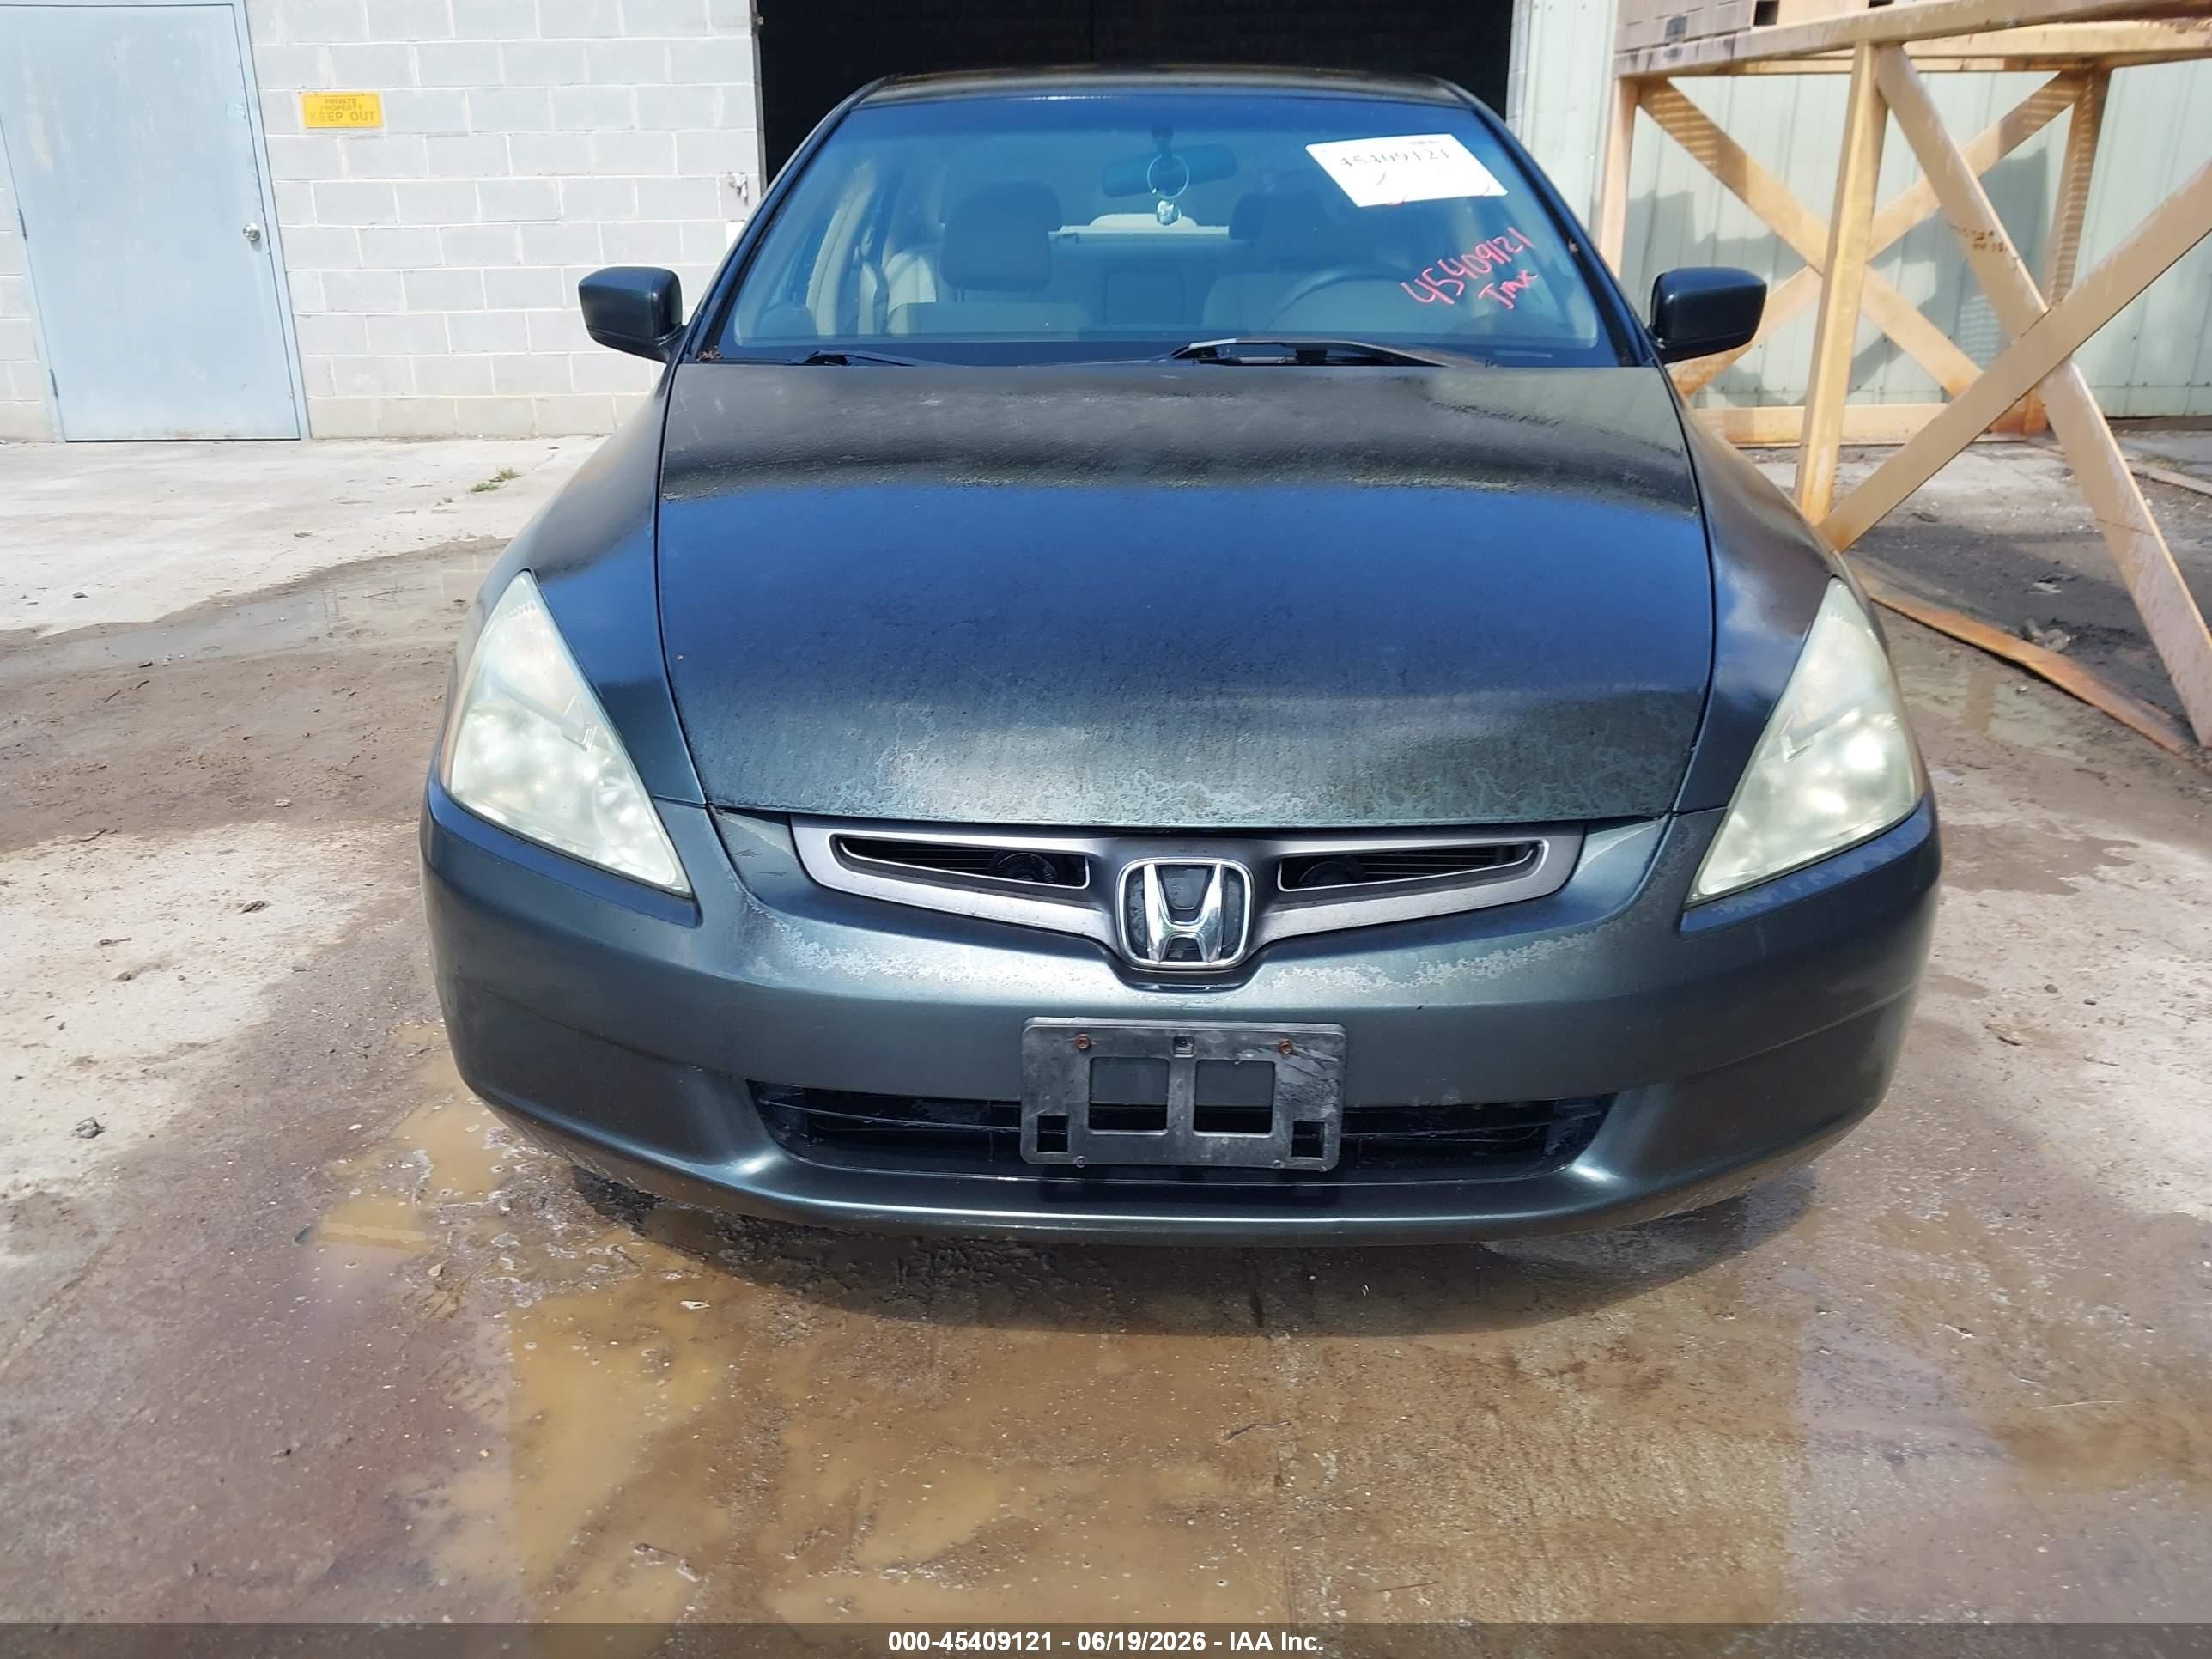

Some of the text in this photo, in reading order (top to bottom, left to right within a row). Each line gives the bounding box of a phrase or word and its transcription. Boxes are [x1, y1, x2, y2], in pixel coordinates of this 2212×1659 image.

[309, 111, 375, 121] KEEP OUT
[1401, 227, 1534, 305] 45409121
